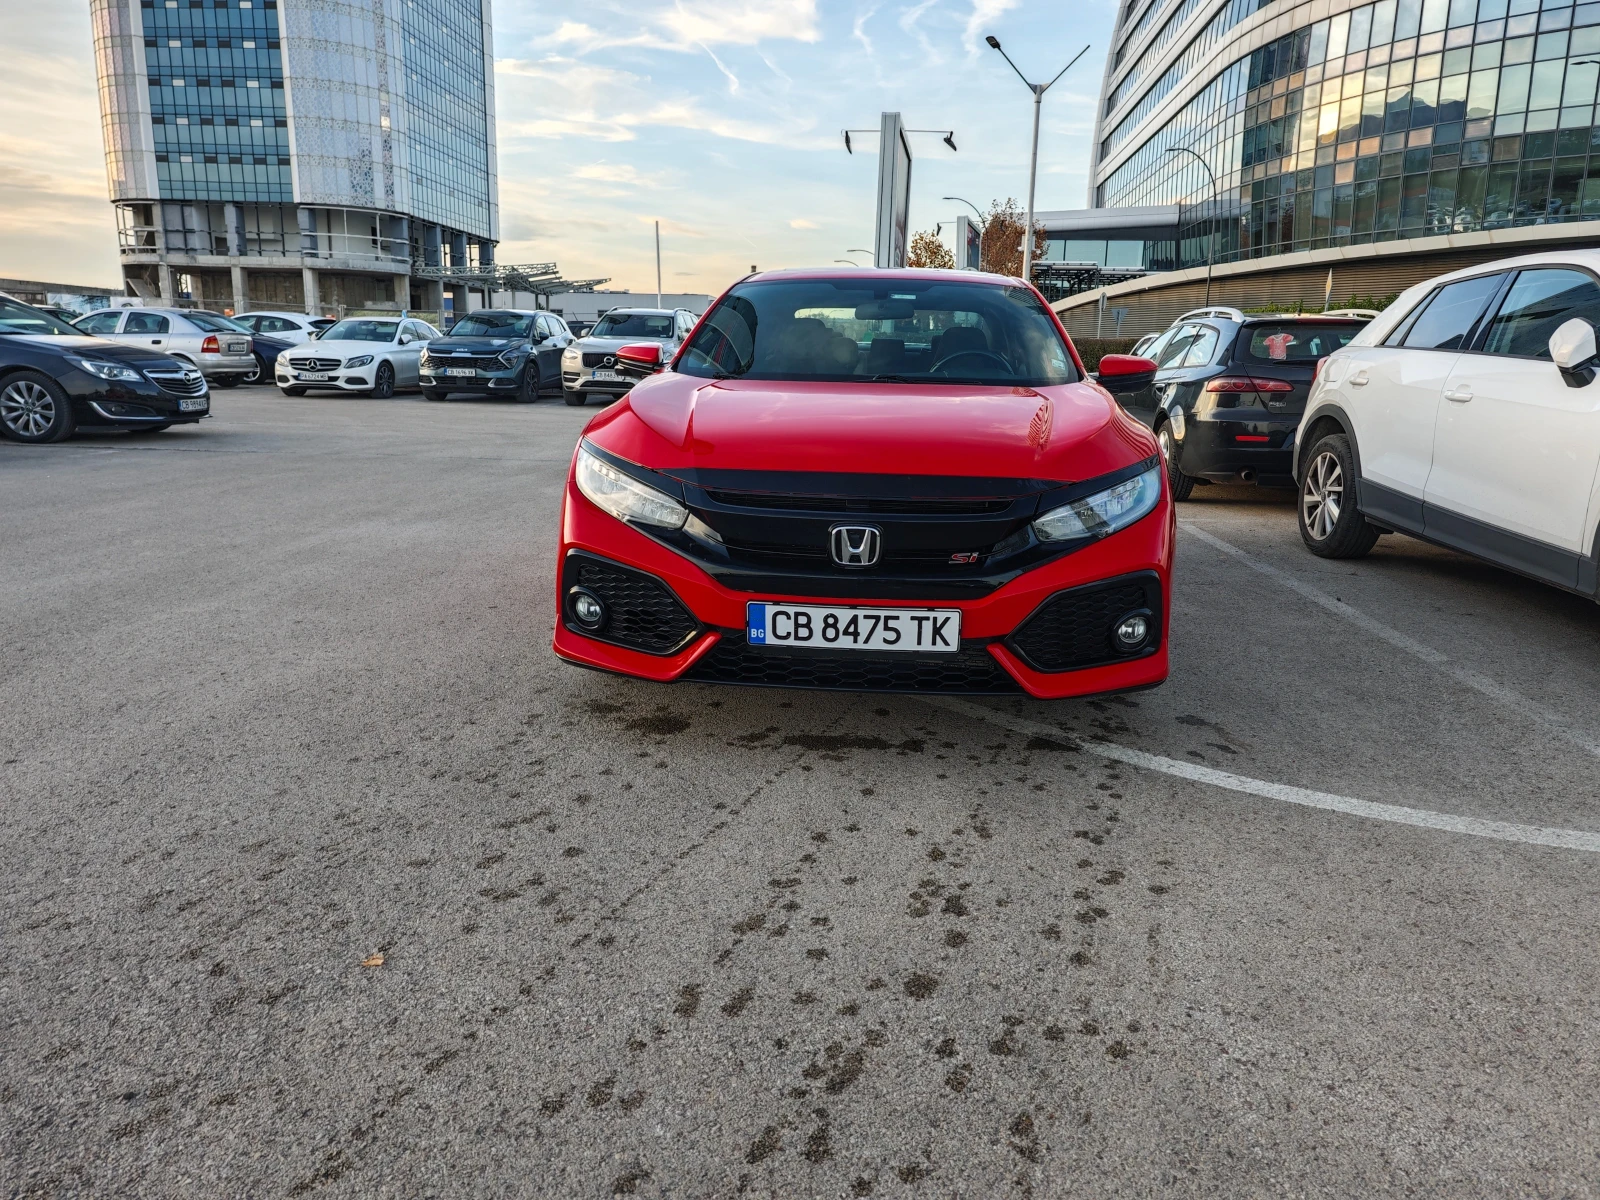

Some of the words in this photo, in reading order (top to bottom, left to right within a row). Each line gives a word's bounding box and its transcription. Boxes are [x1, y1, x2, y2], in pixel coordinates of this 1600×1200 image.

[182, 400, 190, 410] CB
[949, 552, 979, 564] Si
[750, 628, 765, 638] BG
[771, 610, 814, 642] CB
[821, 612, 902, 646] 8475
[910, 615, 952, 647] TK
